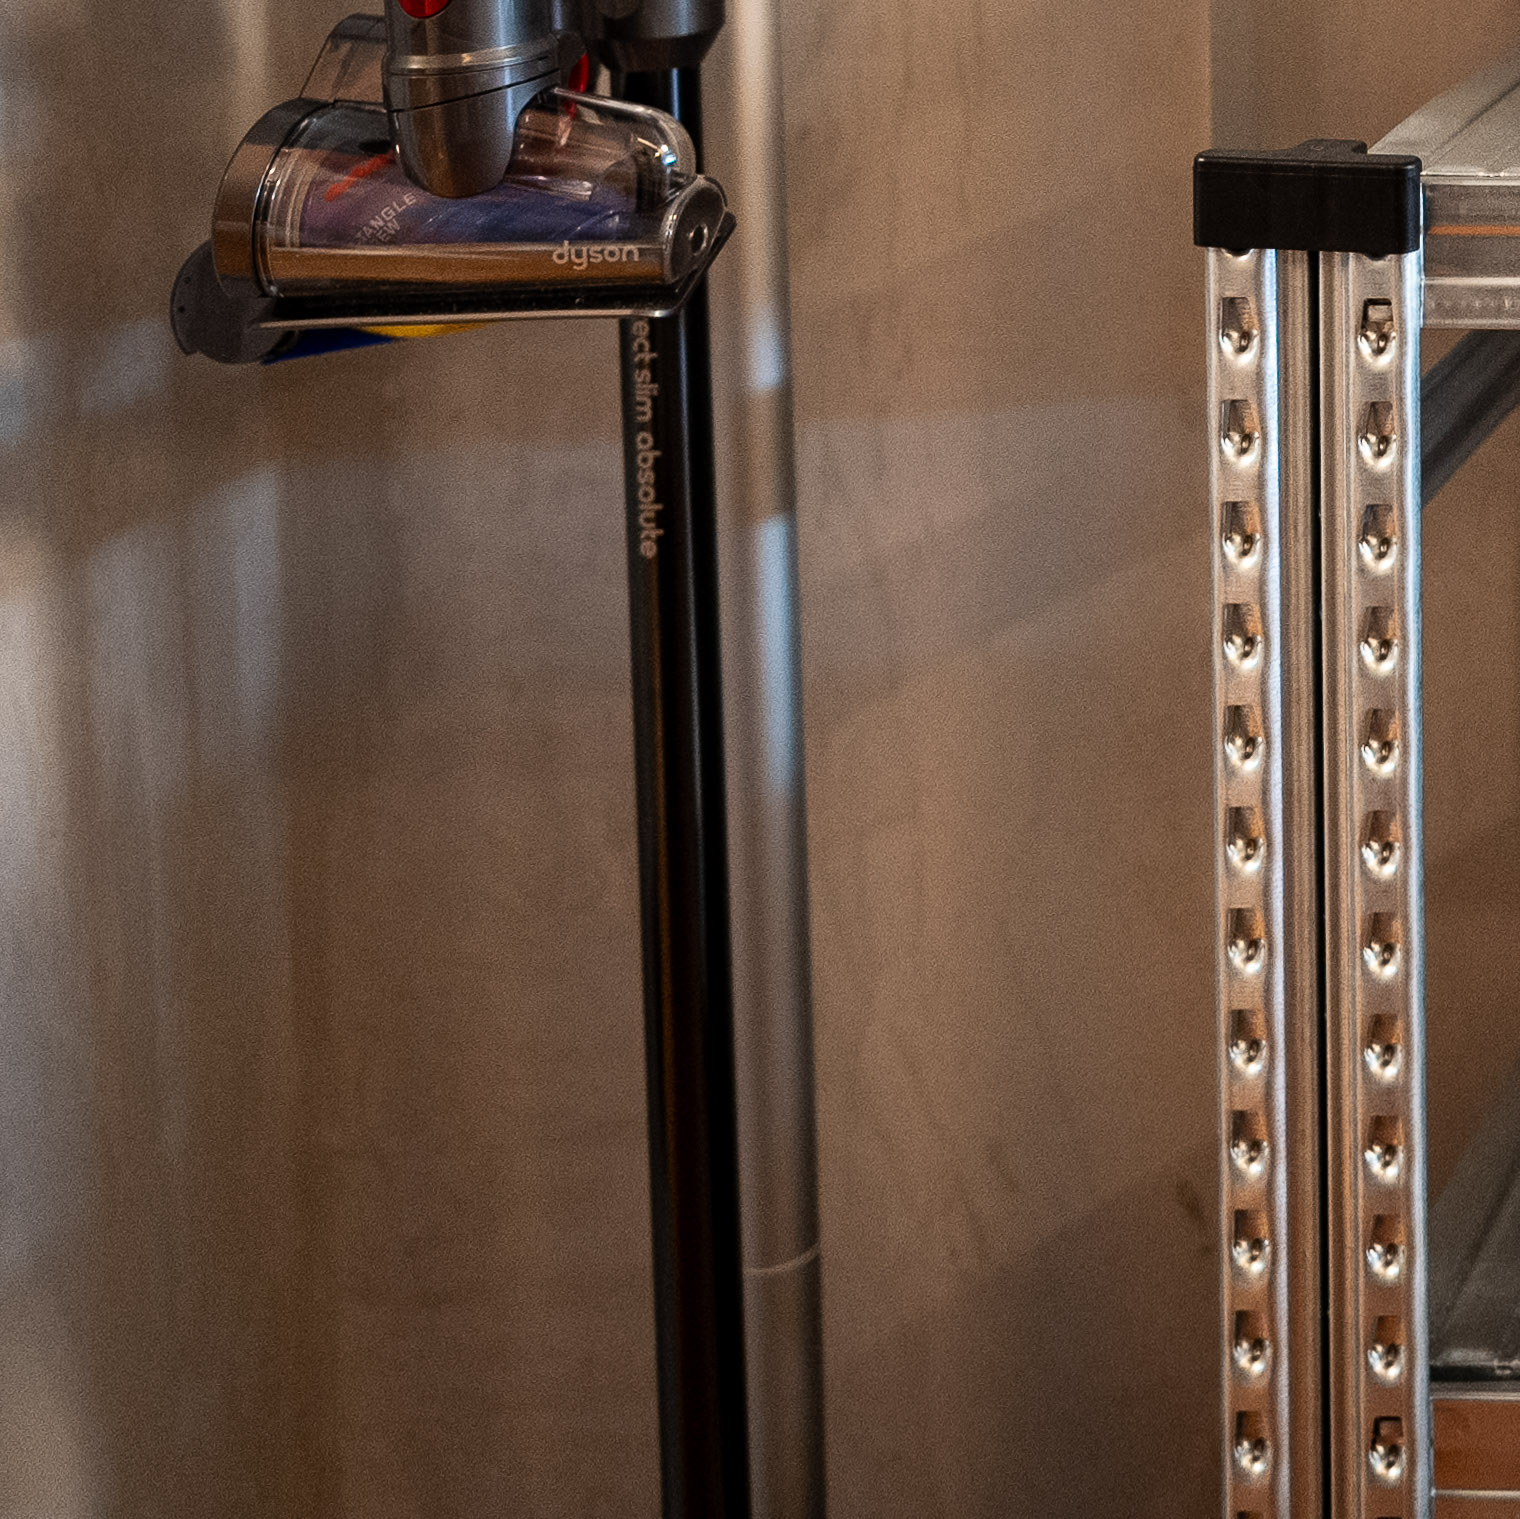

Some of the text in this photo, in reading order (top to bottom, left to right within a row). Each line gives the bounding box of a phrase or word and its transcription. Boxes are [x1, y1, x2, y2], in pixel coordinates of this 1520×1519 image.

[552, 240, 639, 270] dyson
[634, 369, 660, 423] slim
[636, 431, 664, 559] absolute
